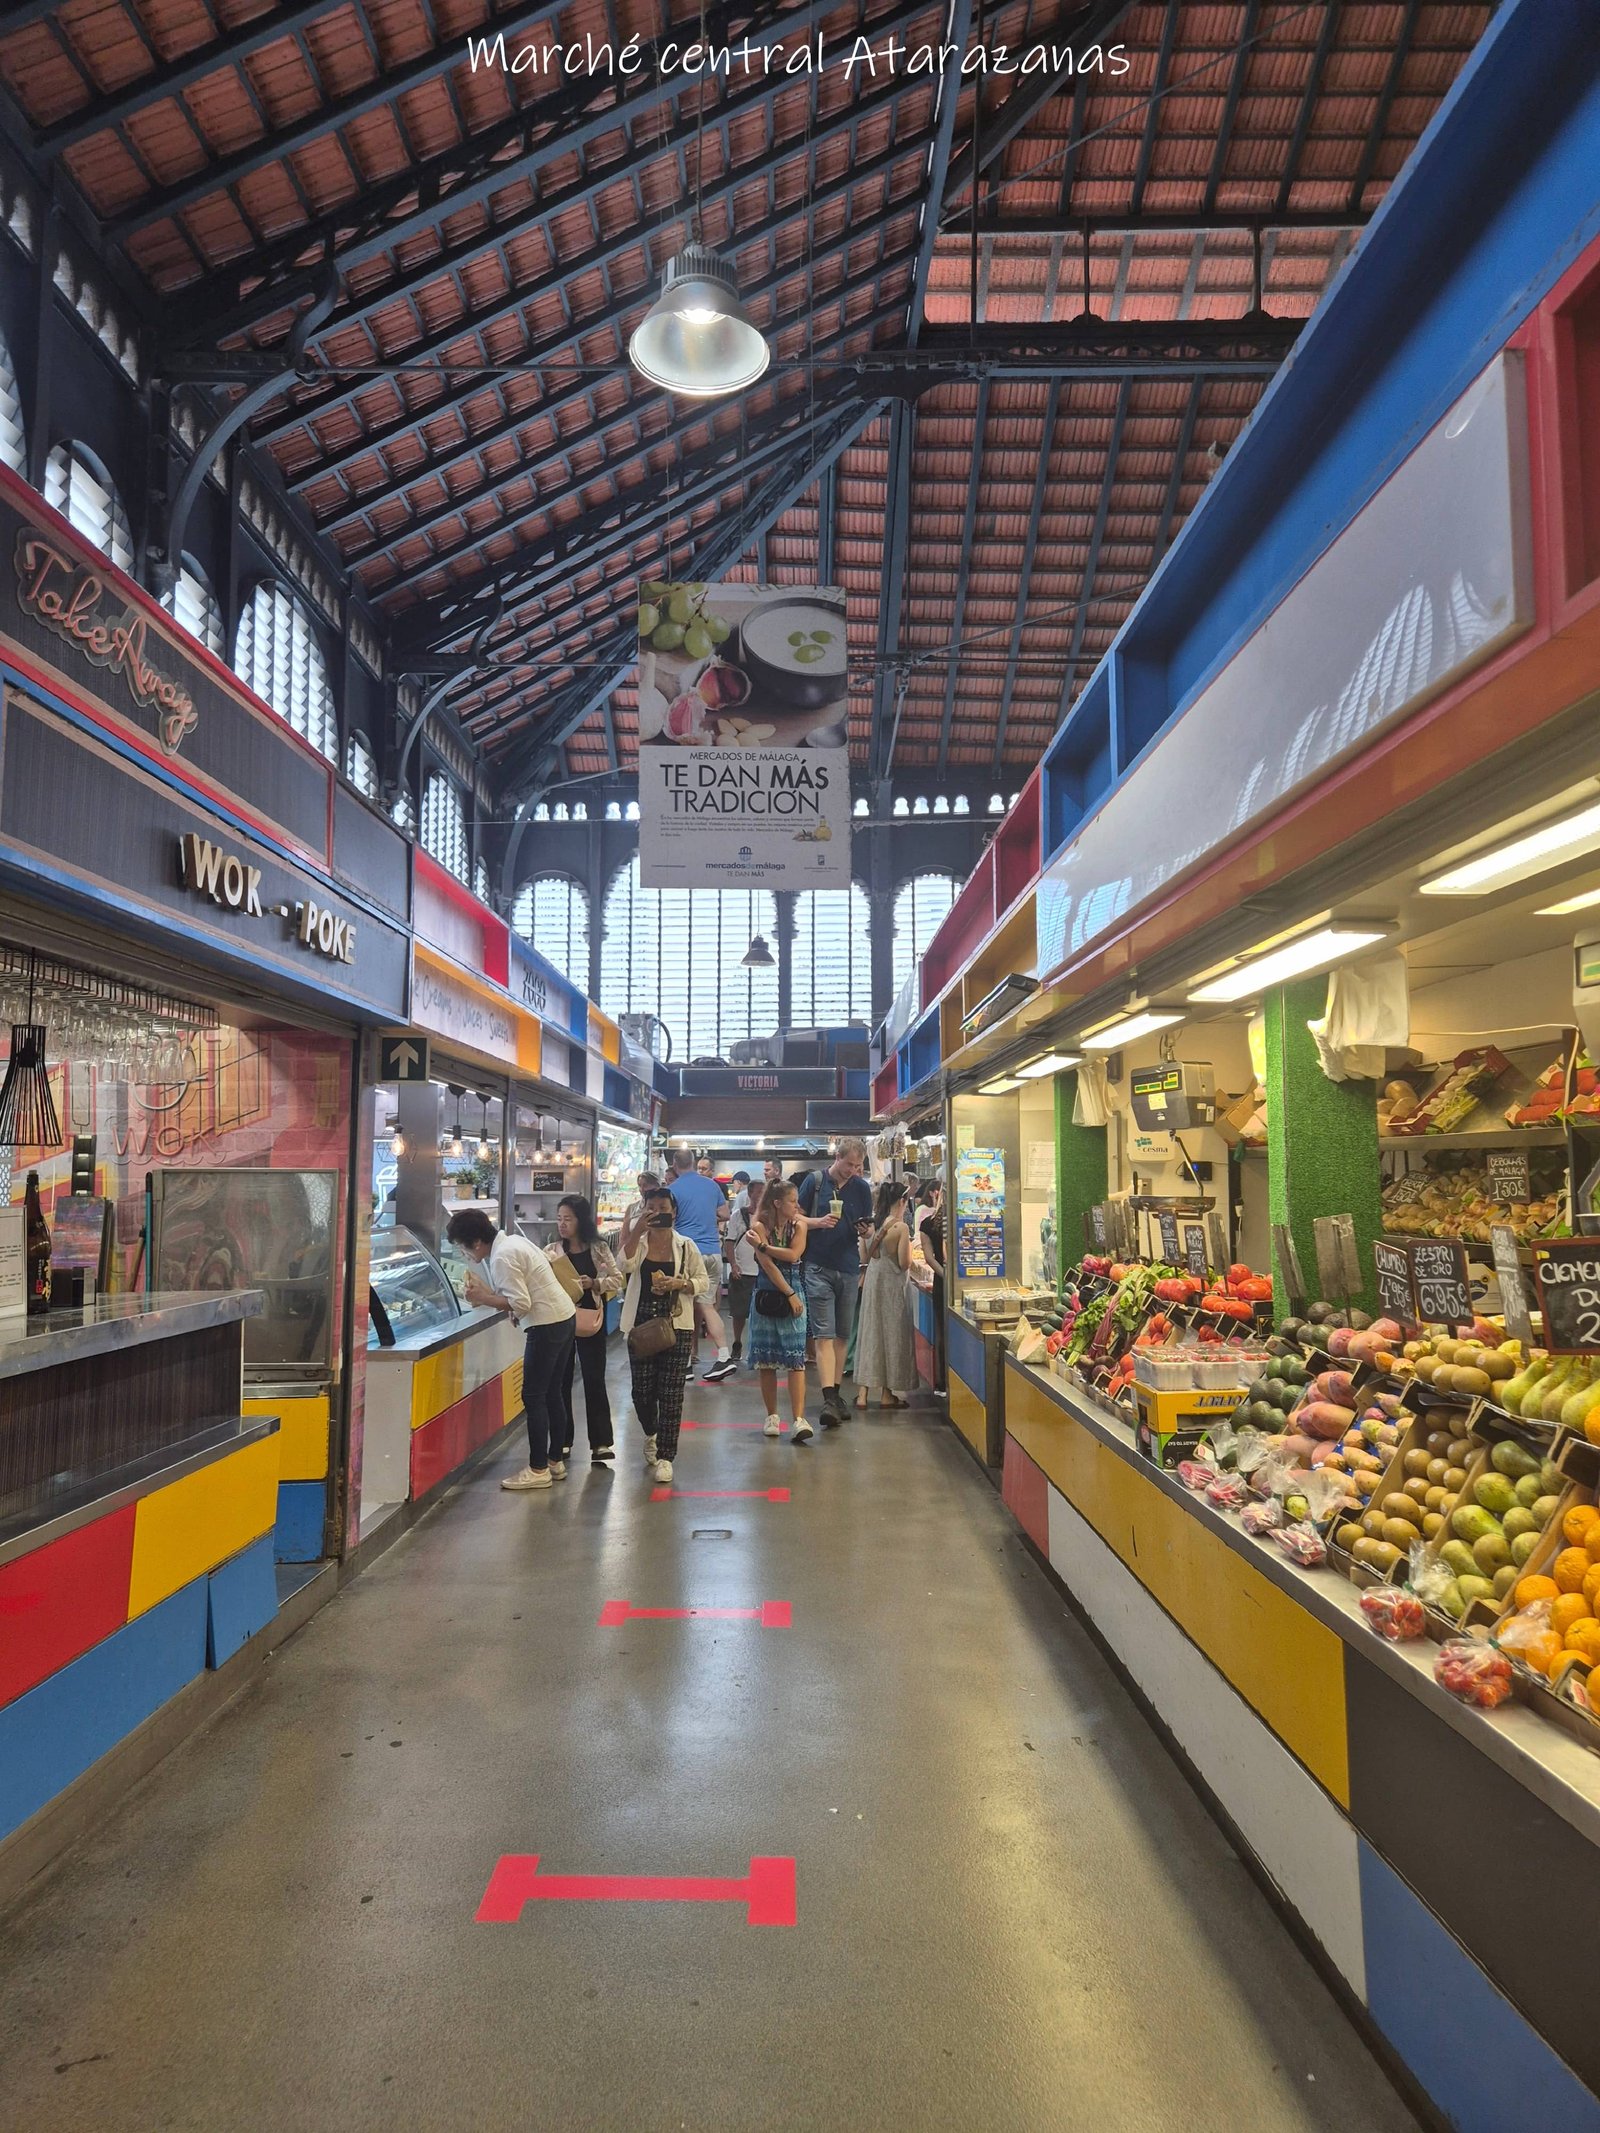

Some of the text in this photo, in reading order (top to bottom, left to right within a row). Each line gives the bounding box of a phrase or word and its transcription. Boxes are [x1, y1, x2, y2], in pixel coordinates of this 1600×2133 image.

[689, 751, 800, 762] MERCADOS DE MÁLAGA
[659, 759, 829, 790] TE DAN MÁS
[669, 789, 819, 815] TRADICIÓN
[180, 832, 357, 965] WOK POKE
[737, 1075, 779, 1088] VICTORIA
[1375, 1244, 1407, 1275] CHUMBO
[1414, 1246, 1454, 1263] ZESPRI
